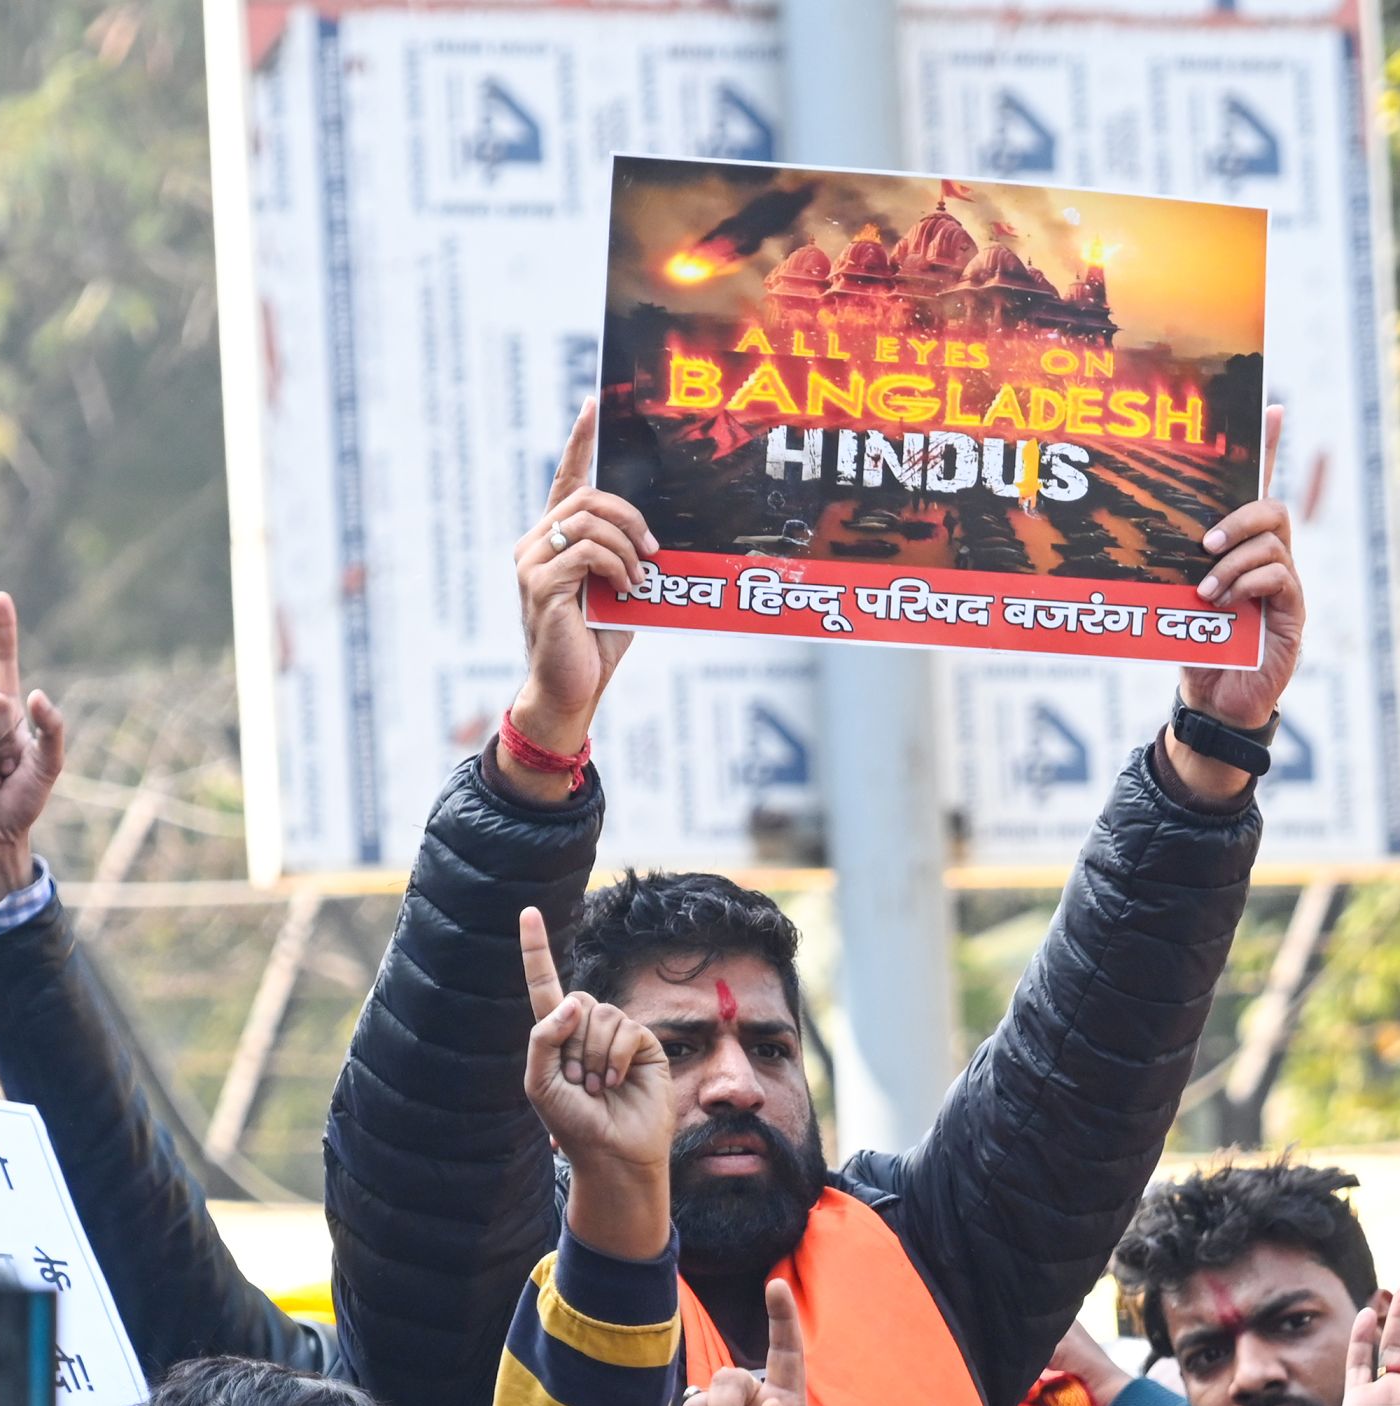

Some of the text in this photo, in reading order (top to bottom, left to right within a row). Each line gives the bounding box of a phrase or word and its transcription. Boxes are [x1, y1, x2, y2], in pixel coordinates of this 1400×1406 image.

[737, 328, 1114, 378] ALL EYES ON
[667, 356, 1205, 443] BANGLADESH
[765, 425, 1090, 503] HINDUS
[737, 567, 852, 633] हिन्दू
[856, 579, 990, 626] परिषद
[1004, 590, 1146, 638] बजरंग
[1155, 608, 1237, 644] दल
[33, 1246, 72, 1293] के
